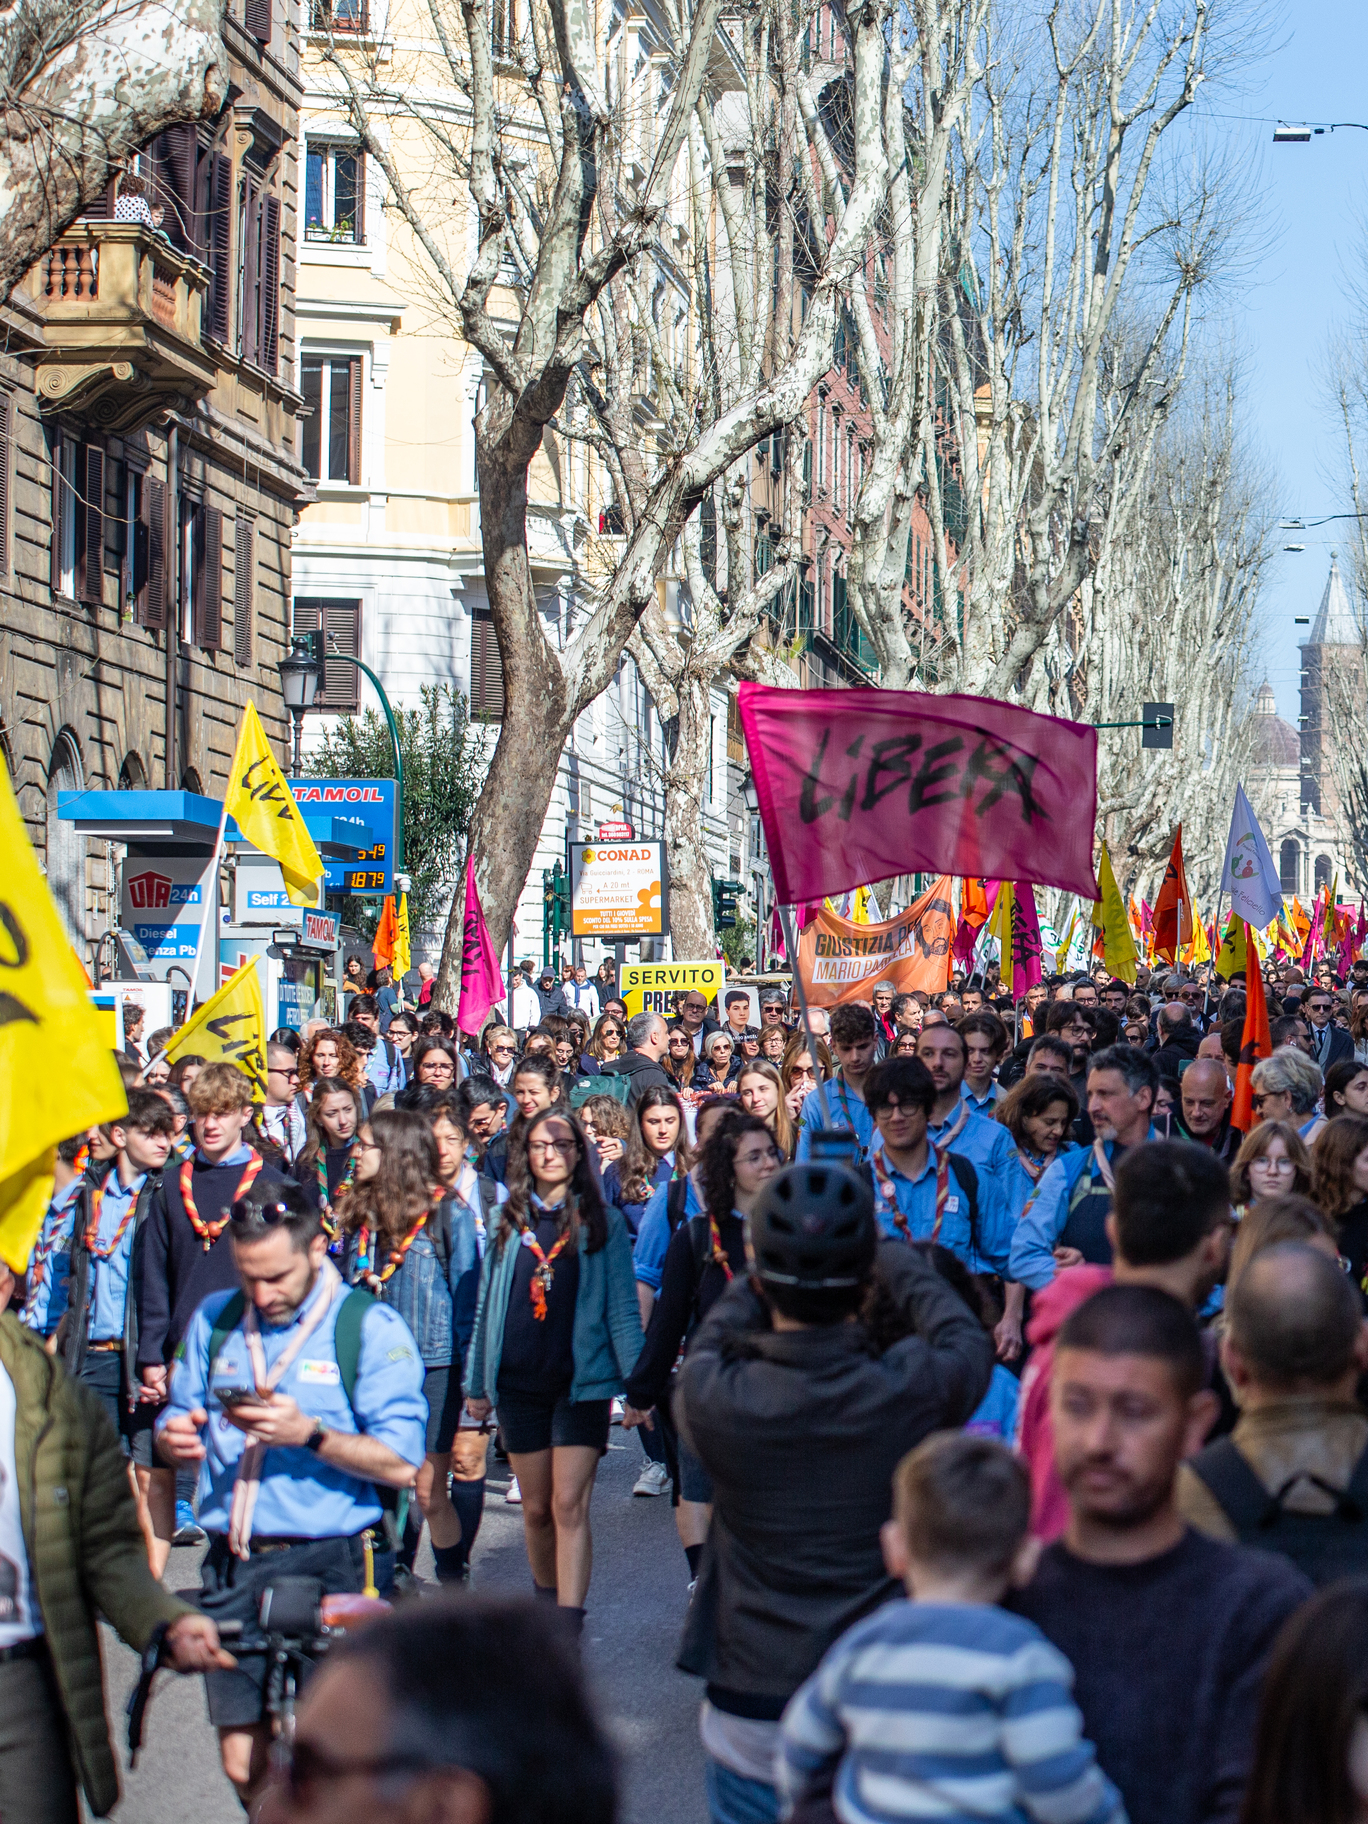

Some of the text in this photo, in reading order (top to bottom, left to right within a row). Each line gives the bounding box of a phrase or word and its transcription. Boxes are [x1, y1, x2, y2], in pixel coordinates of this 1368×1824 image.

[292, 787, 384, 802] TAMOIL
[597, 849, 651, 861] CONAD
[171, 889, 198, 902] 24h
[251, 893, 279, 905] Self
[580, 895, 633, 904] SUPERMARKET
[1239, 890, 1266, 916] Feliciello
[139, 927, 177, 939] Diesel
[305, 913, 336, 943] TAMOIL
[179, 944, 197, 956] Pb
[814, 930, 894, 957] GIUSTIZIA
[815, 959, 861, 980] MARIO
[628, 969, 715, 985] SERVITO
